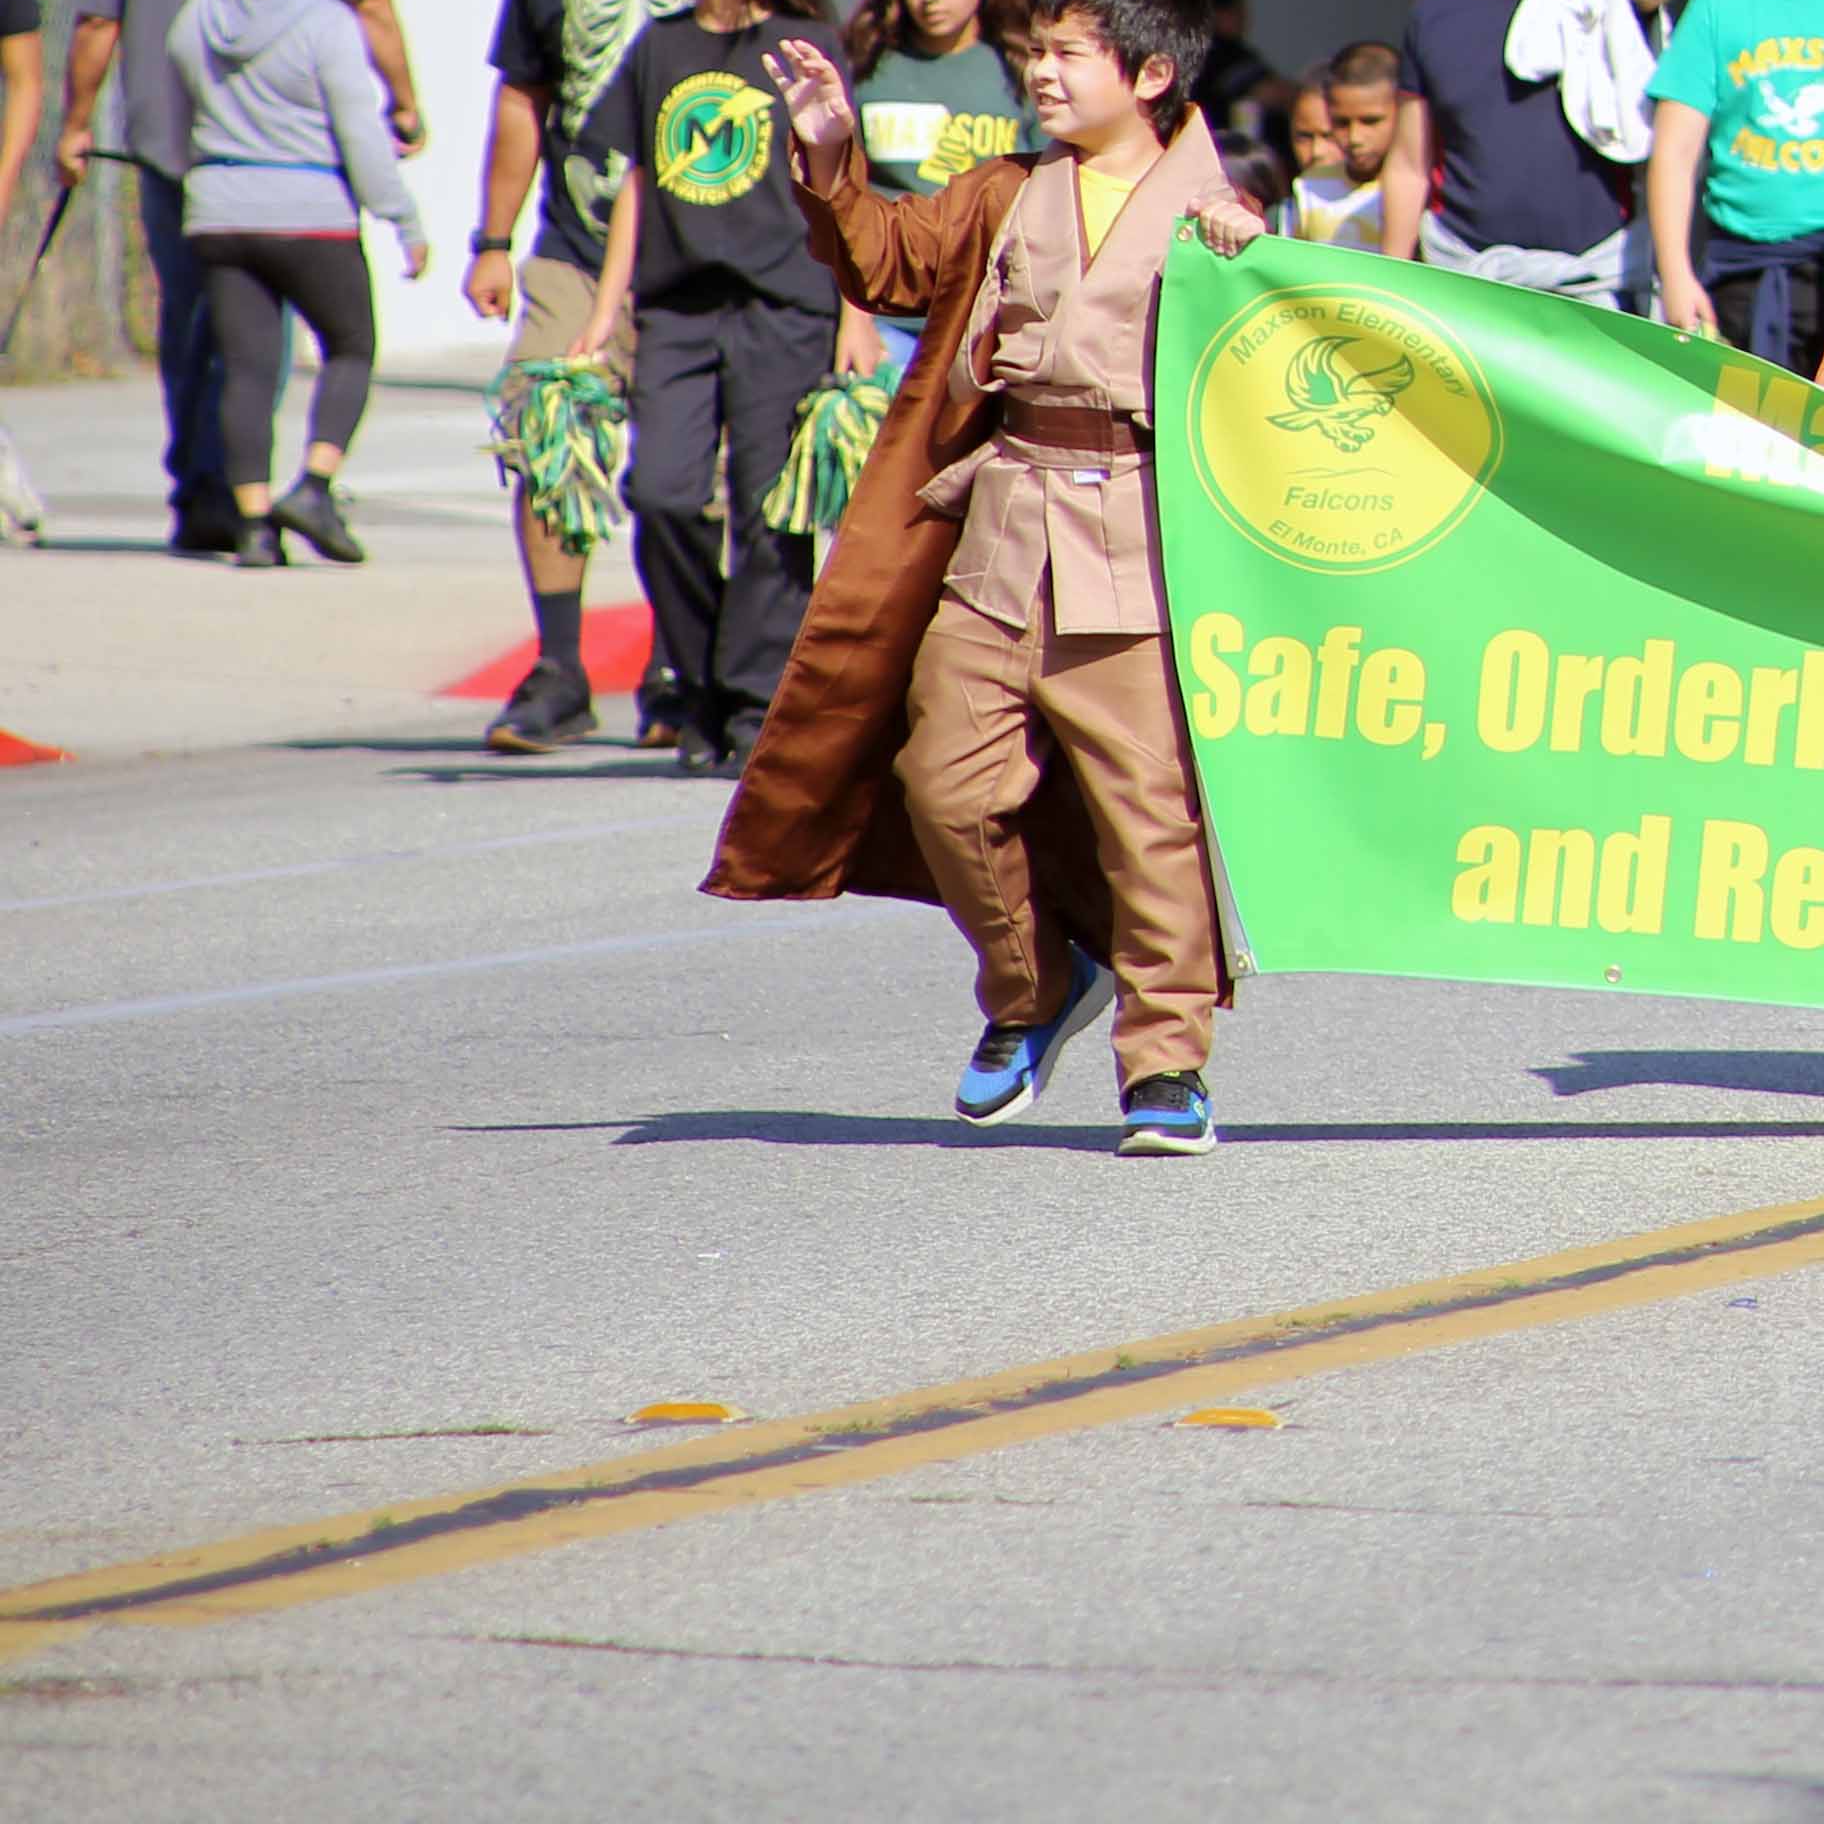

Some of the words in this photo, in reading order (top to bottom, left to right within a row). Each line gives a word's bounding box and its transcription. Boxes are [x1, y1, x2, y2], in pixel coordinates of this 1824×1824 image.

[1229, 302, 1326, 366] Maxson
[1336, 302, 1472, 399] Elementary
[1267, 518, 1293, 540] El
[1291, 528, 1369, 556] Monte,
[1373, 526, 1404, 550] CA
[1283, 484, 1395, 513] Falcons
[1190, 610, 1447, 761] Safe,
[1450, 812, 1666, 935] and
